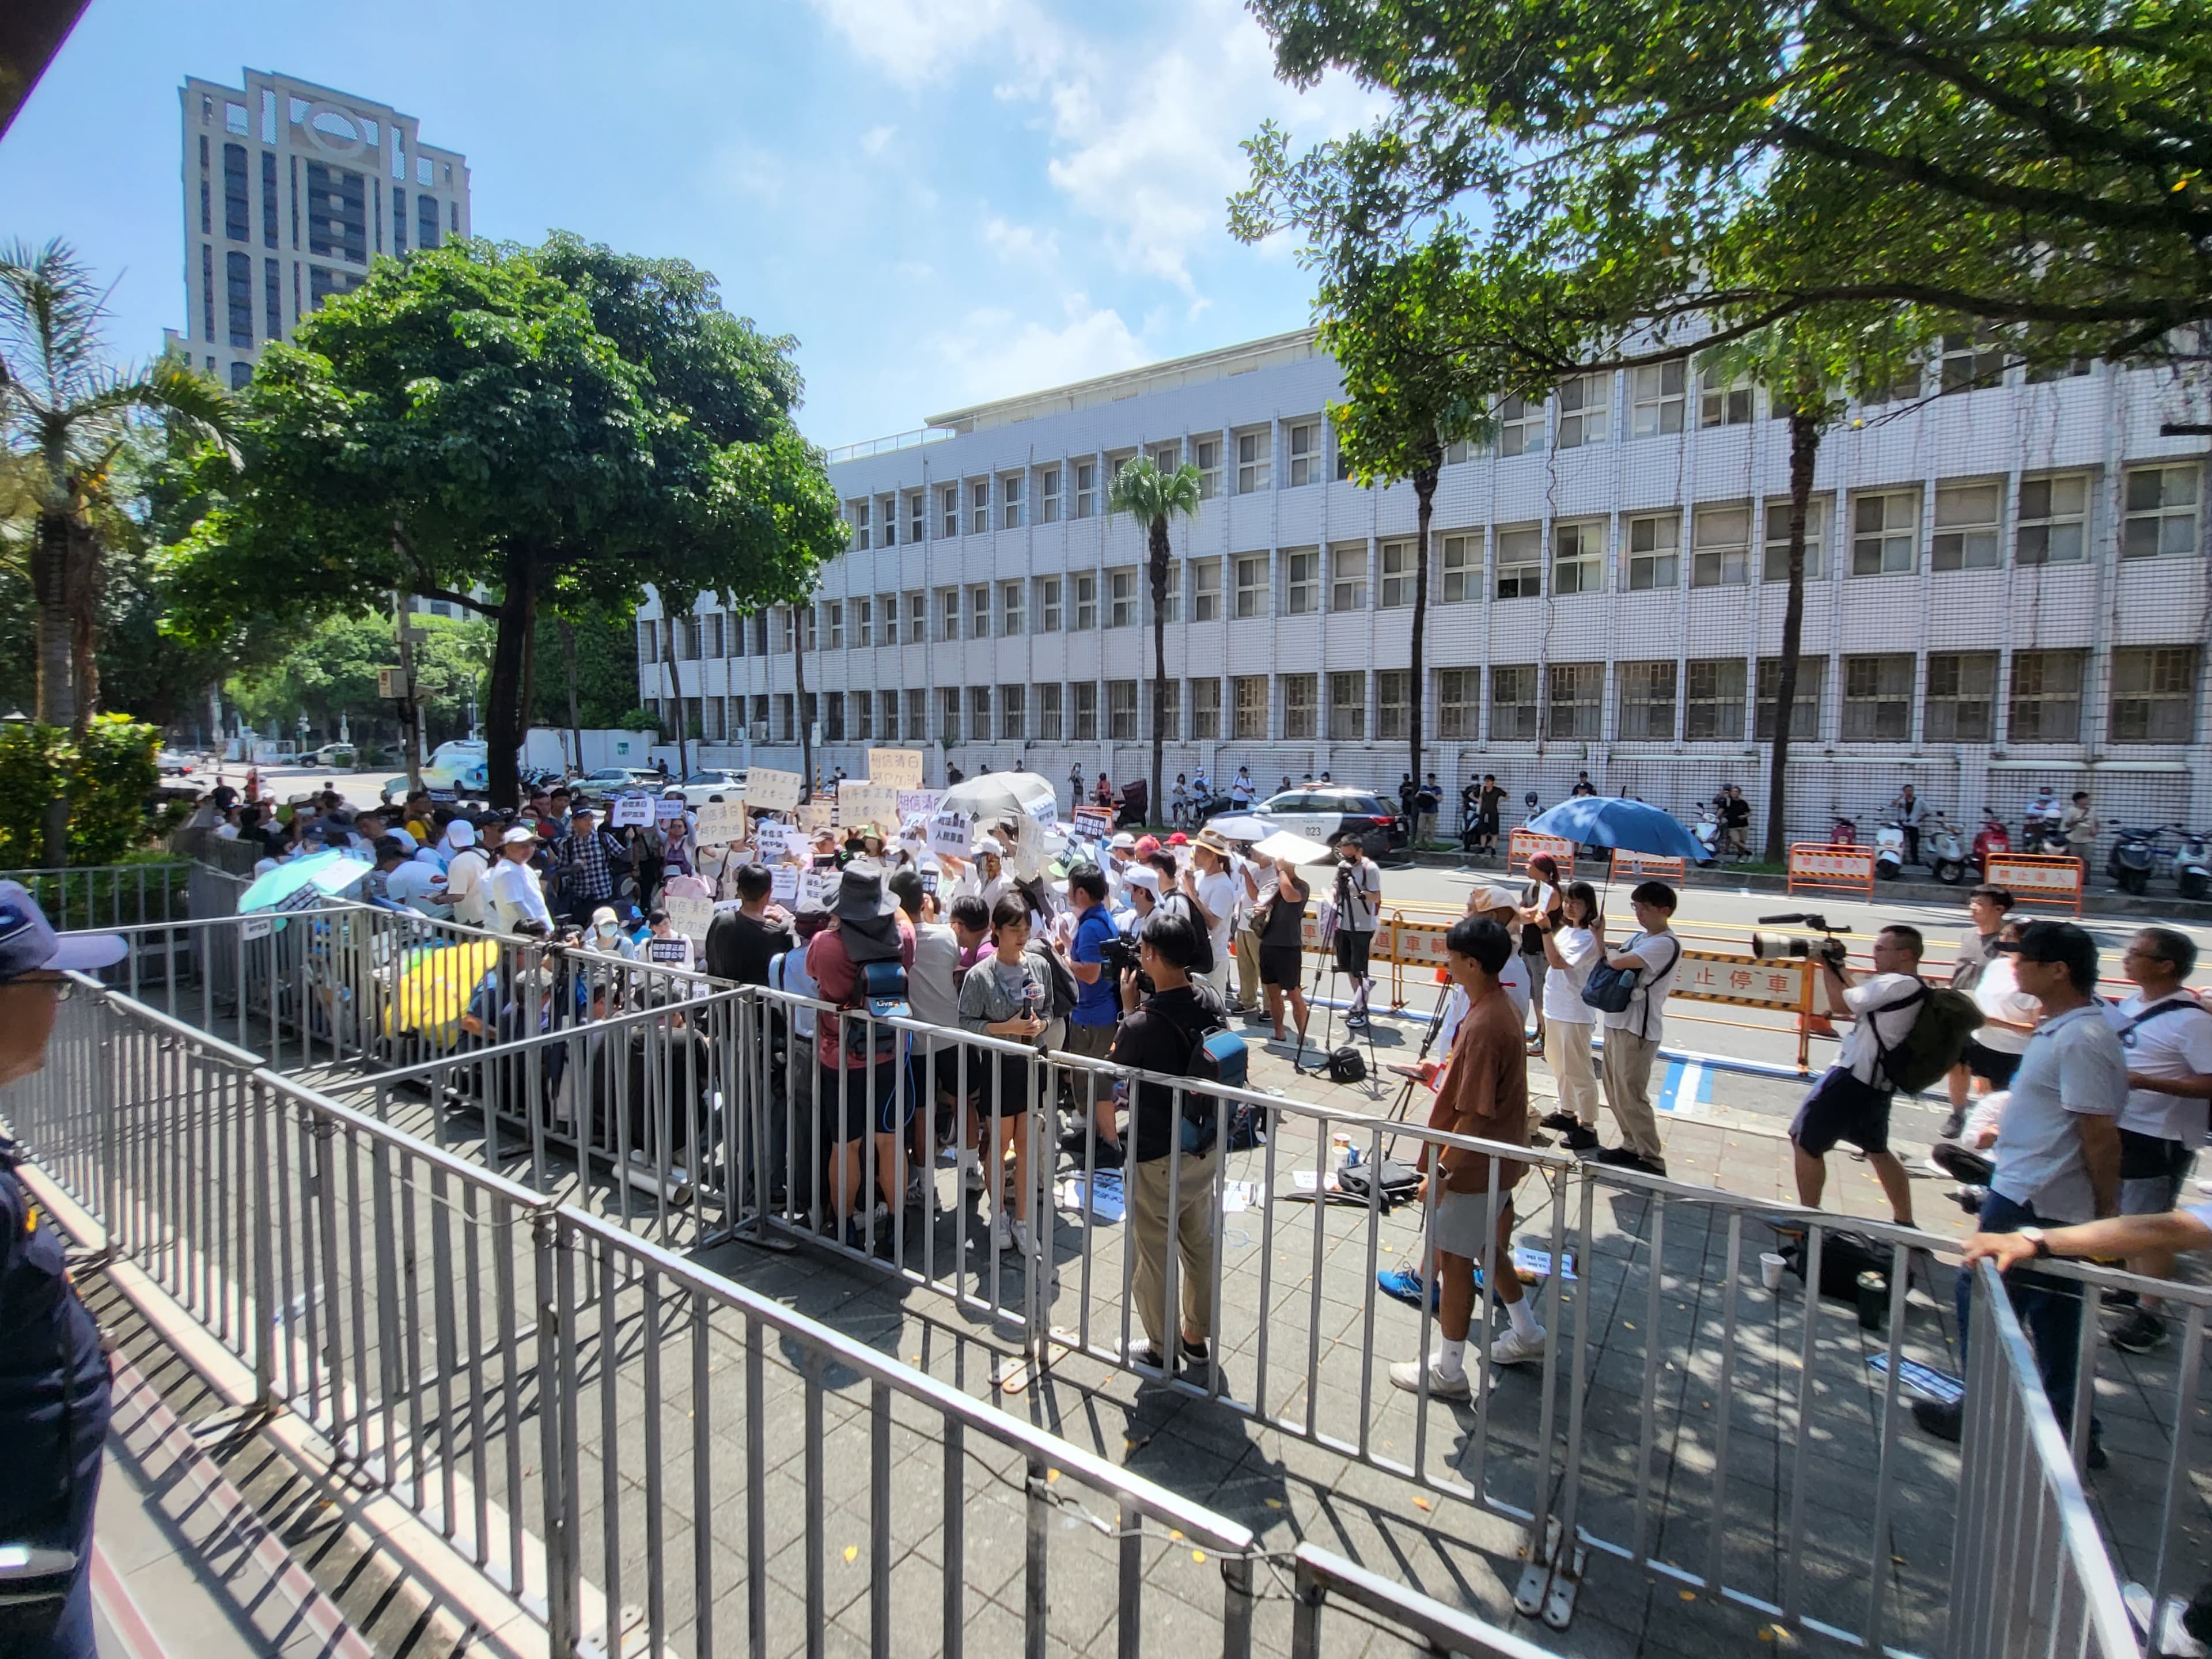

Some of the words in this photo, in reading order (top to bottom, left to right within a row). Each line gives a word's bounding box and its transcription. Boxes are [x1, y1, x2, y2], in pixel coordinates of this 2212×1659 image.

[871, 754, 919, 768] 相信清白
[1305, 827, 1321, 836] 023
[1675, 965, 1790, 994] 止停車
